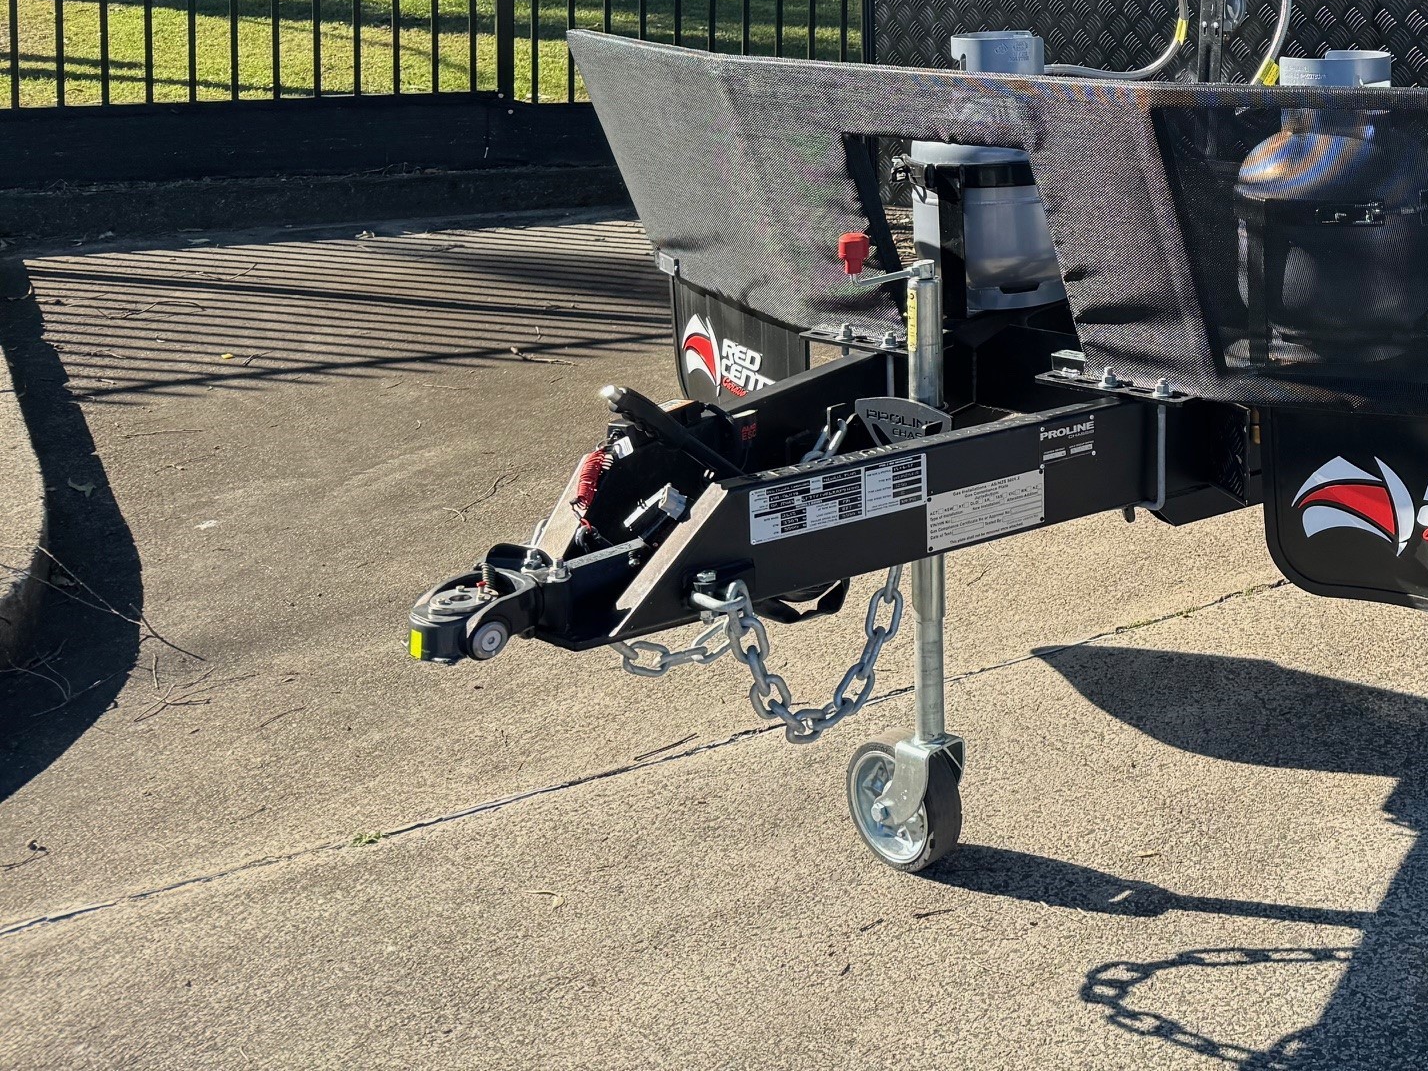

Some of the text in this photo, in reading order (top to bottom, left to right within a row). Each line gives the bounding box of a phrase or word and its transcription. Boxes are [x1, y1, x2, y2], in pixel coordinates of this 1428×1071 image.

[721, 338, 763, 371] RED
[721, 359, 776, 391] CENT
[866, 408, 942, 429] PROLIN
[892, 428, 923, 440] CHAS
[1039, 421, 1095, 441] PROLINE
